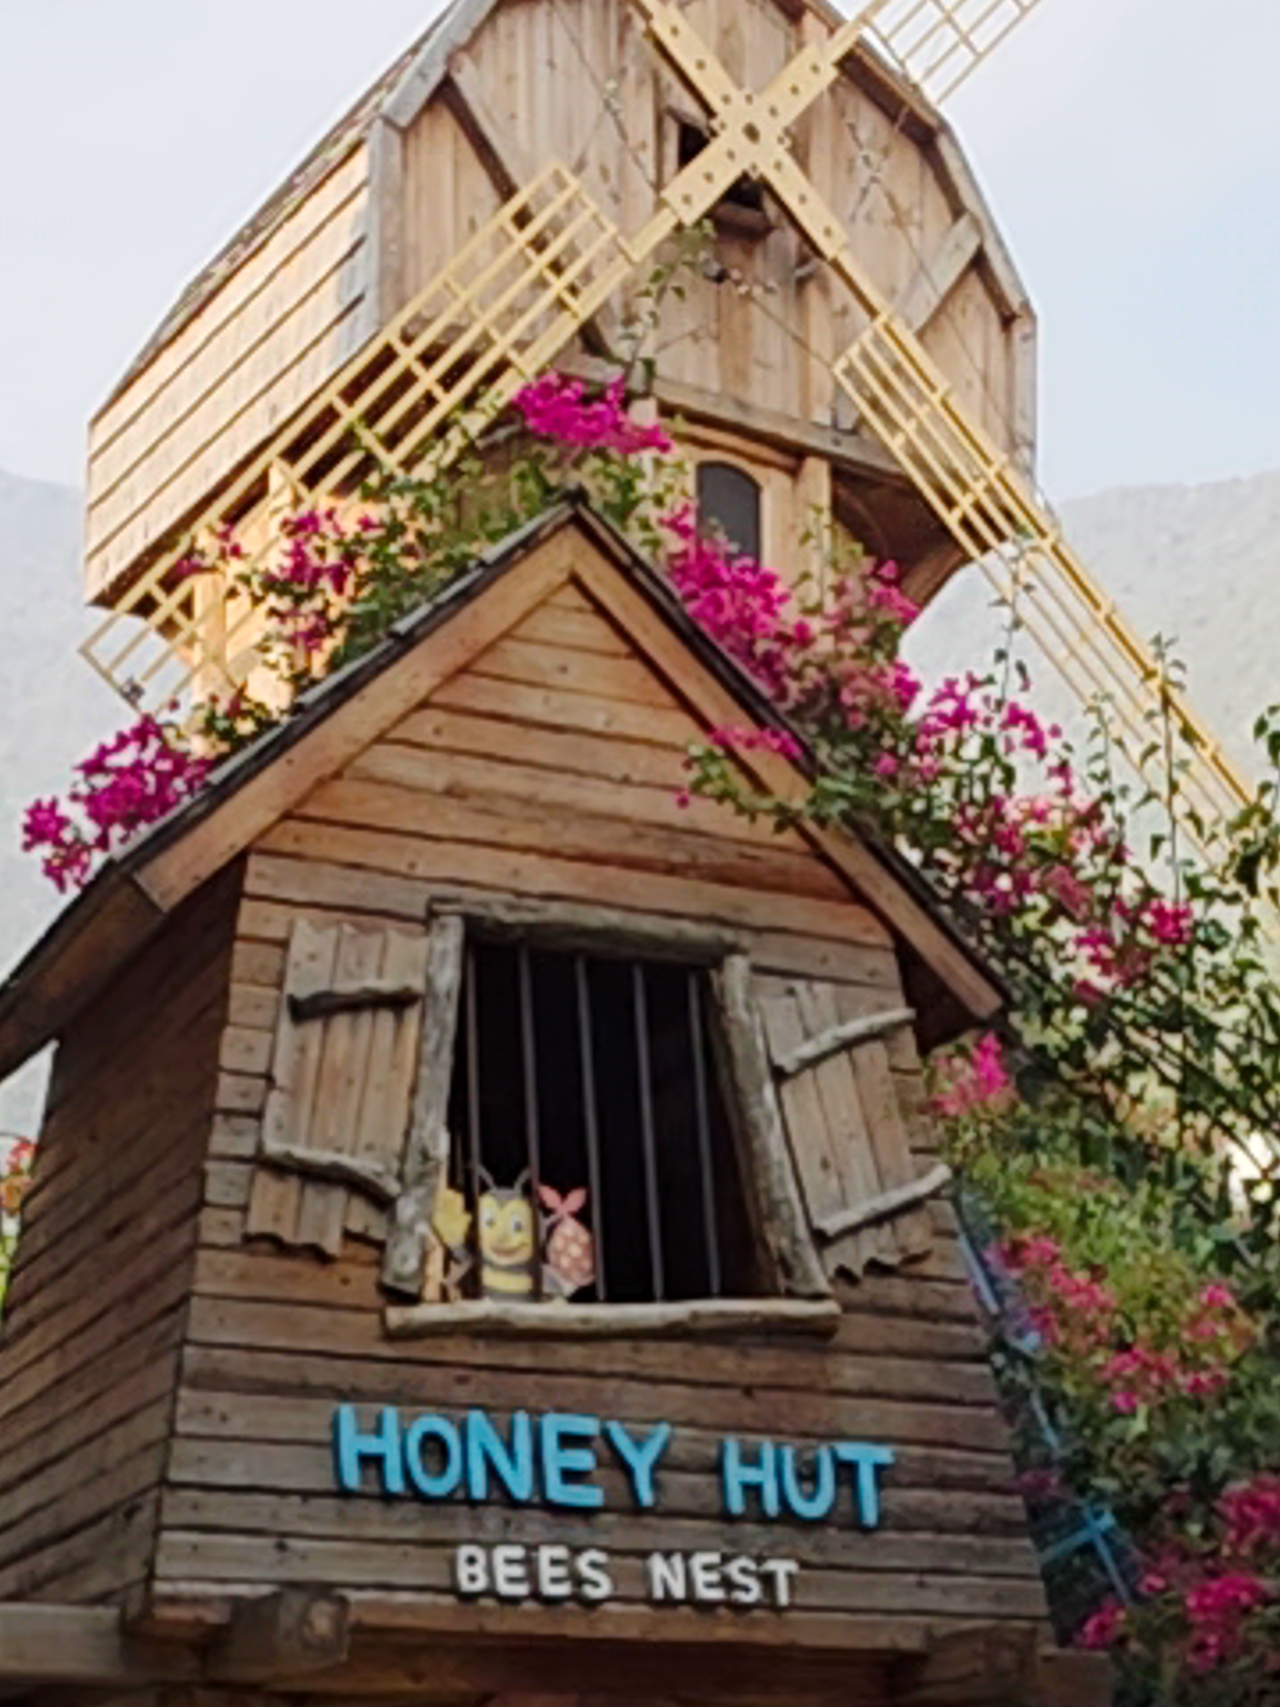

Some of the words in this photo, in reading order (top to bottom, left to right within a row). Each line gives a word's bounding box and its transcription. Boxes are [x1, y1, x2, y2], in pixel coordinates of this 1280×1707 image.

[334, 1401, 671, 1508] HONEY
[720, 1437, 895, 1528] HUT
[455, 1544, 614, 1600] BEES
[648, 1552, 799, 1607] NEST
